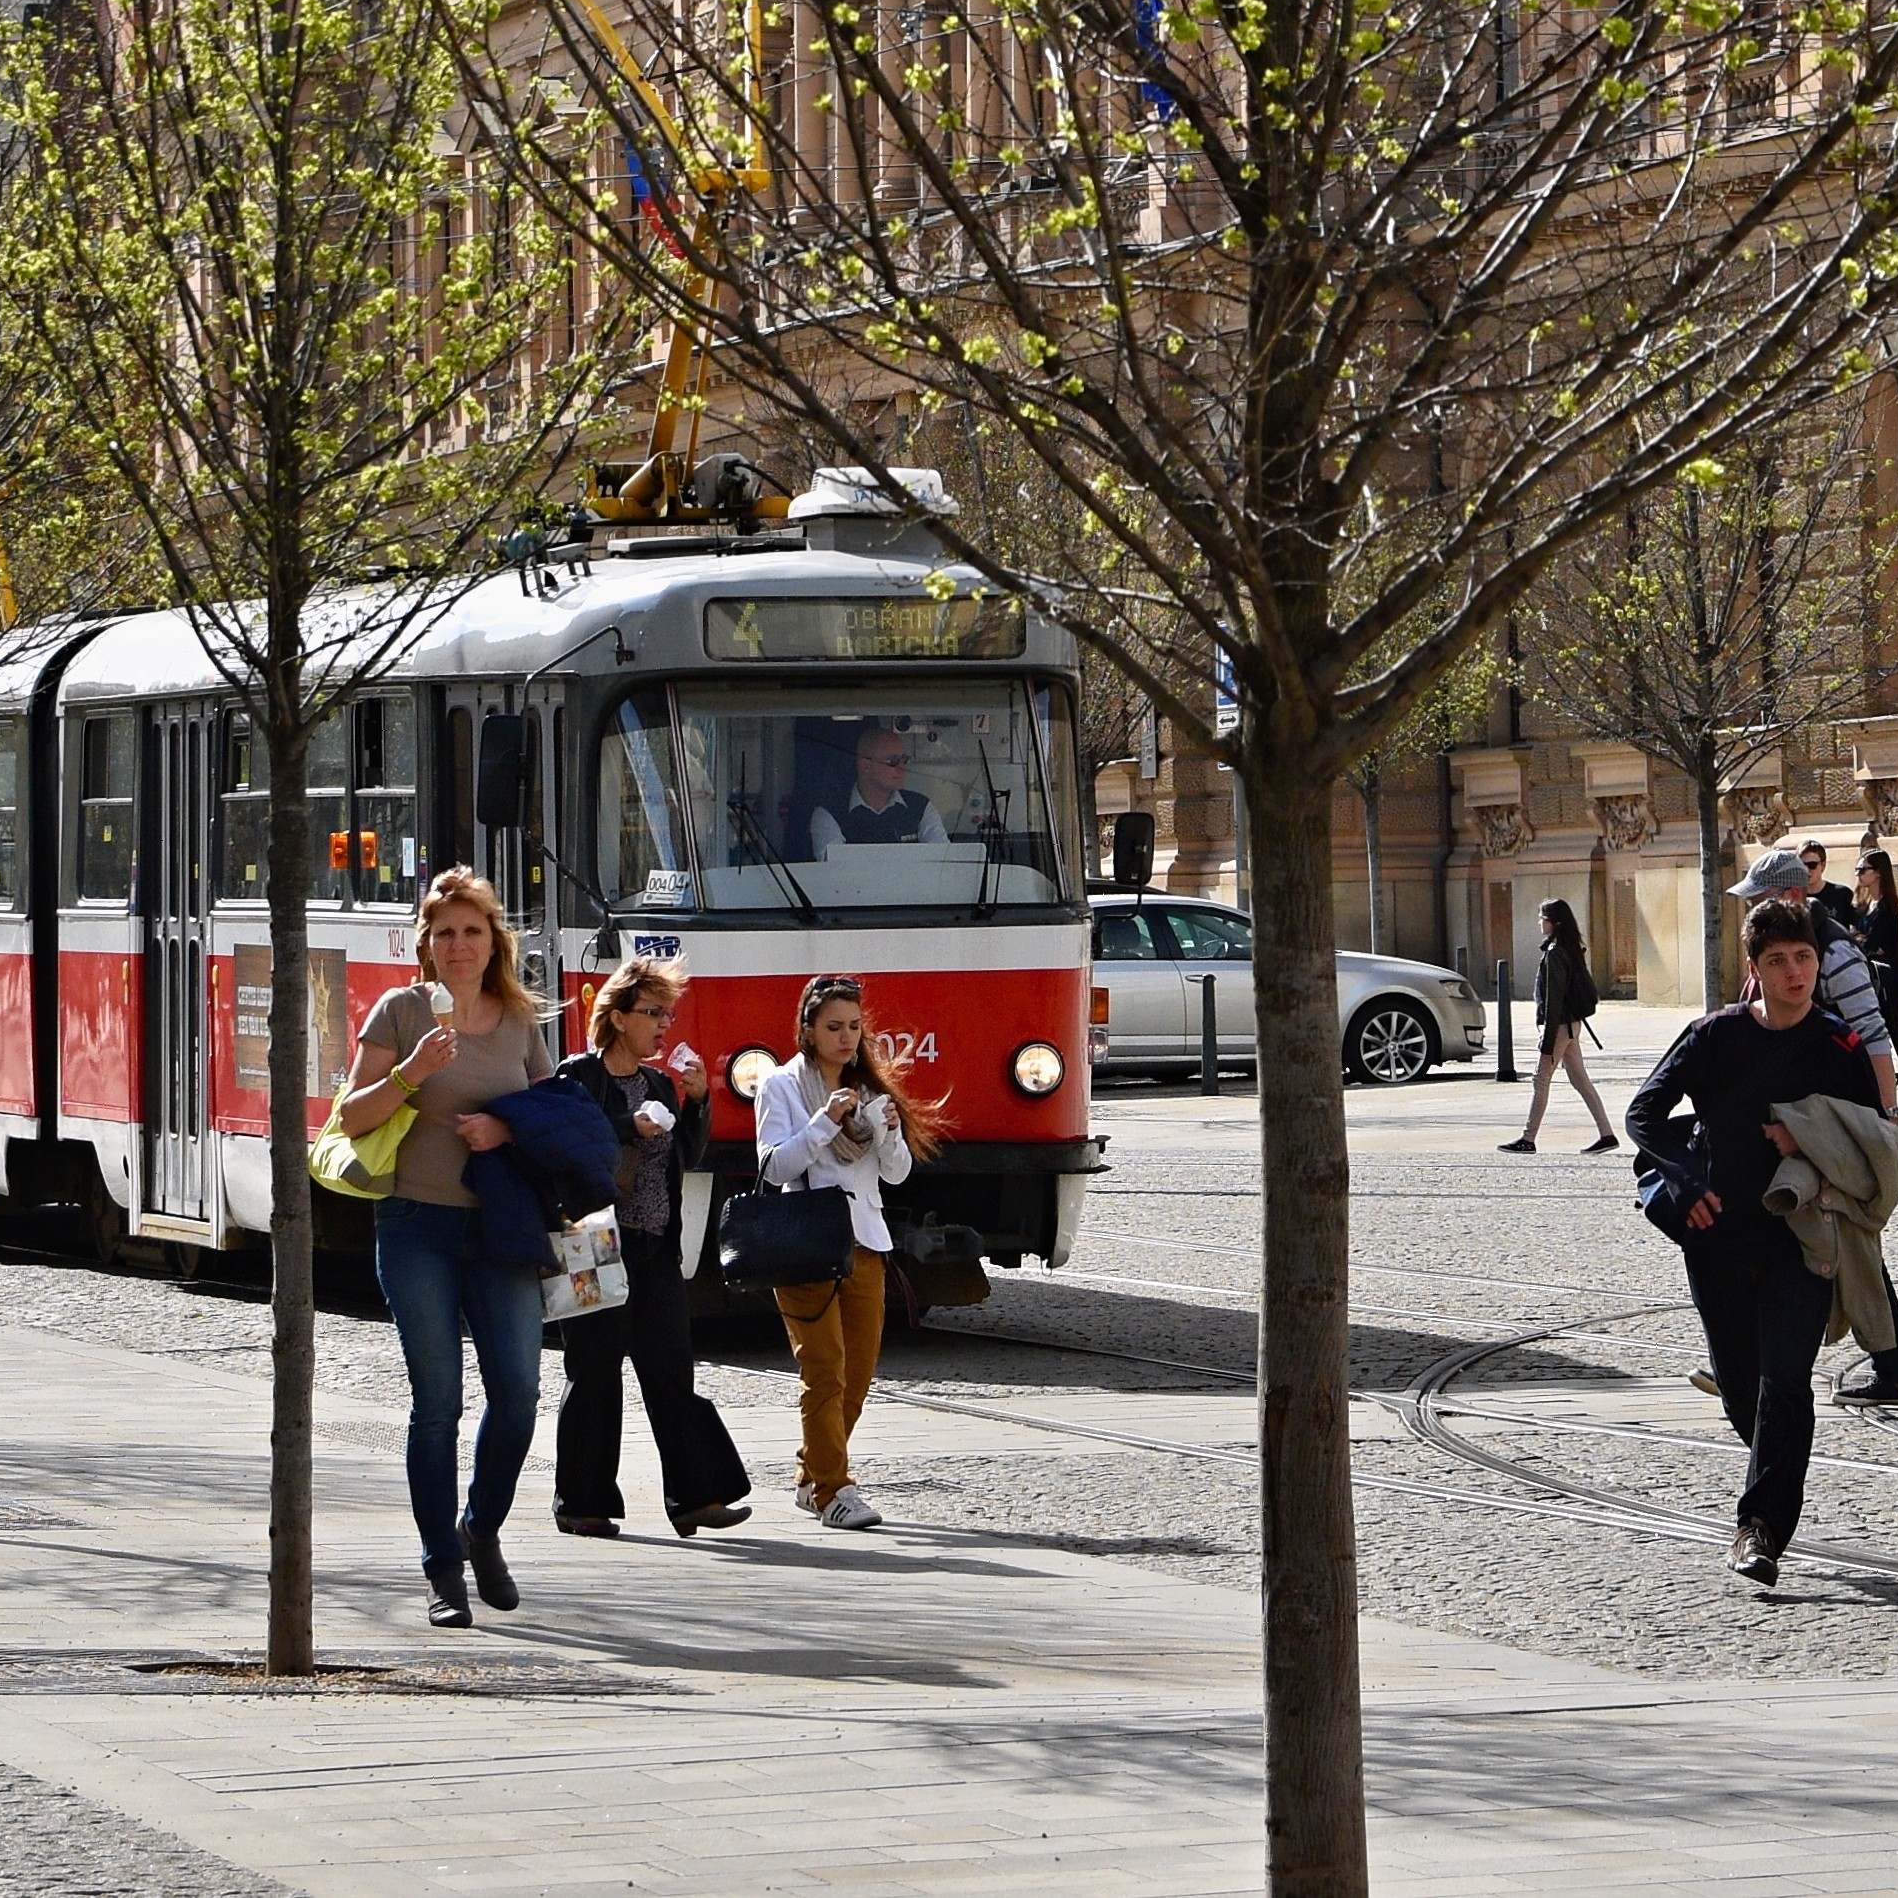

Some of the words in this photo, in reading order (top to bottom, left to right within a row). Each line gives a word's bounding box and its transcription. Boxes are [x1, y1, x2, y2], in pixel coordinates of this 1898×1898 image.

[733, 602, 763, 657] 4
[388, 929, 406, 958] 1024
[873, 1032, 939, 1065] 024
